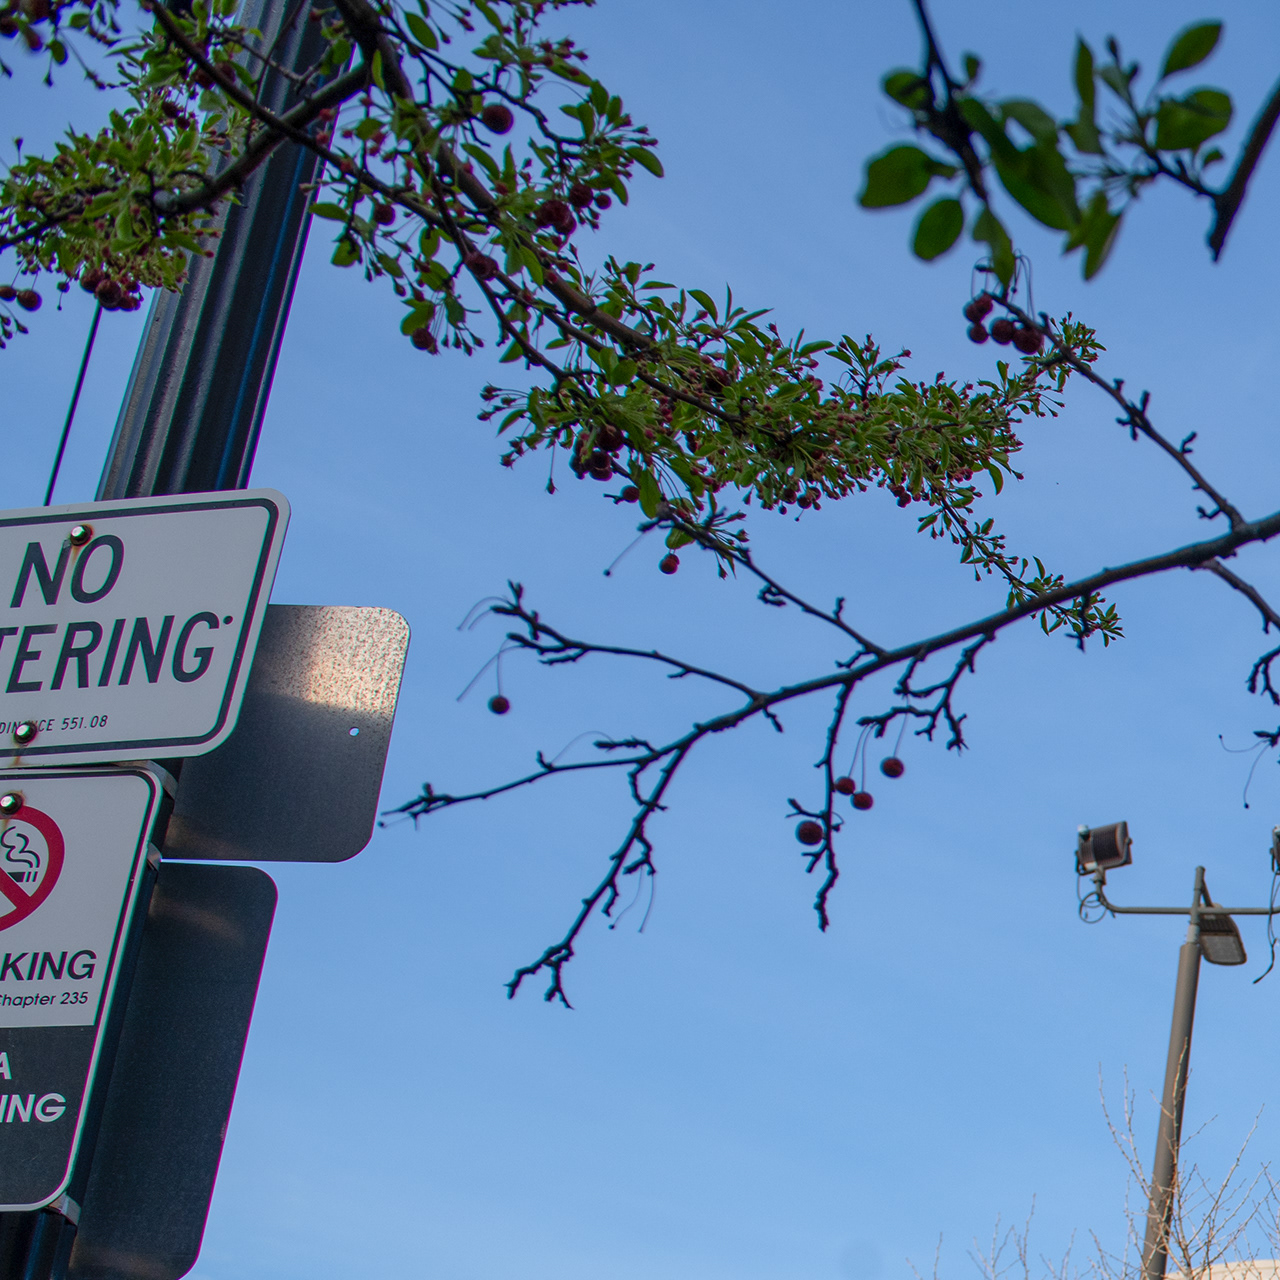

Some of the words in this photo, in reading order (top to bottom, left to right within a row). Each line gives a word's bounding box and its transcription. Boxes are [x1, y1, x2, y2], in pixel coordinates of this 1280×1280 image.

[10, 533, 125, 608] NO
[0, 718, 55, 734] DINCE
[61, 714, 108, 731] 551.08
[0, 949, 97, 981] KING
[60, 991, 88, 1005] 235
